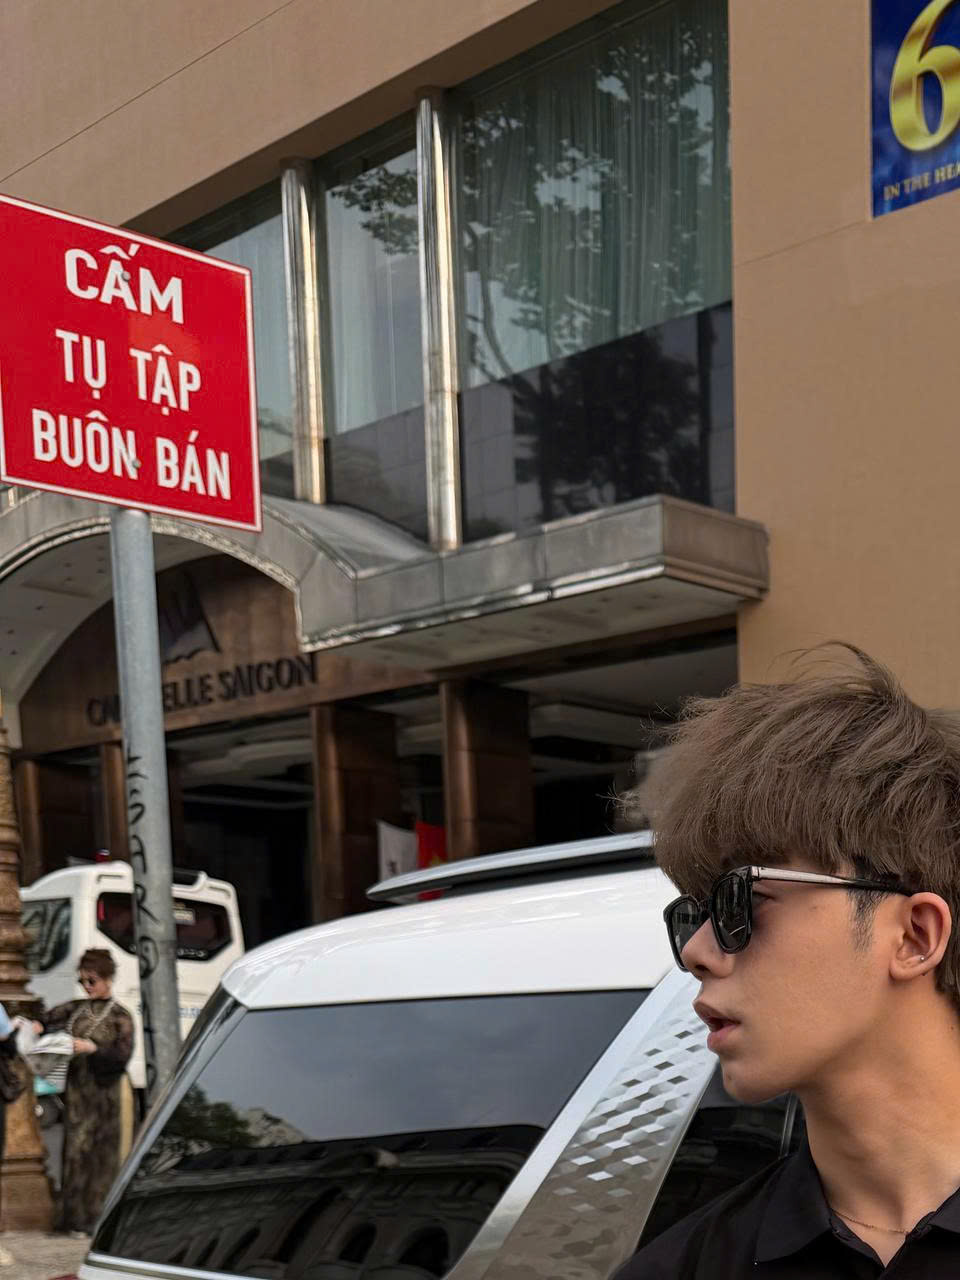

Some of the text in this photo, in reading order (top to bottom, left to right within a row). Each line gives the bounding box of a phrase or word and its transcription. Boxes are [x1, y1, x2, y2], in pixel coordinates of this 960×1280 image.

[883, 182, 900, 201] IN
[904, 171, 931, 194] THE
[64, 243, 185, 325] CẤM
[55, 328, 202, 416] TỤ TẬP
[32, 408, 232, 500] BUÔN BÁN
[218, 651, 319, 700] SAIGON
